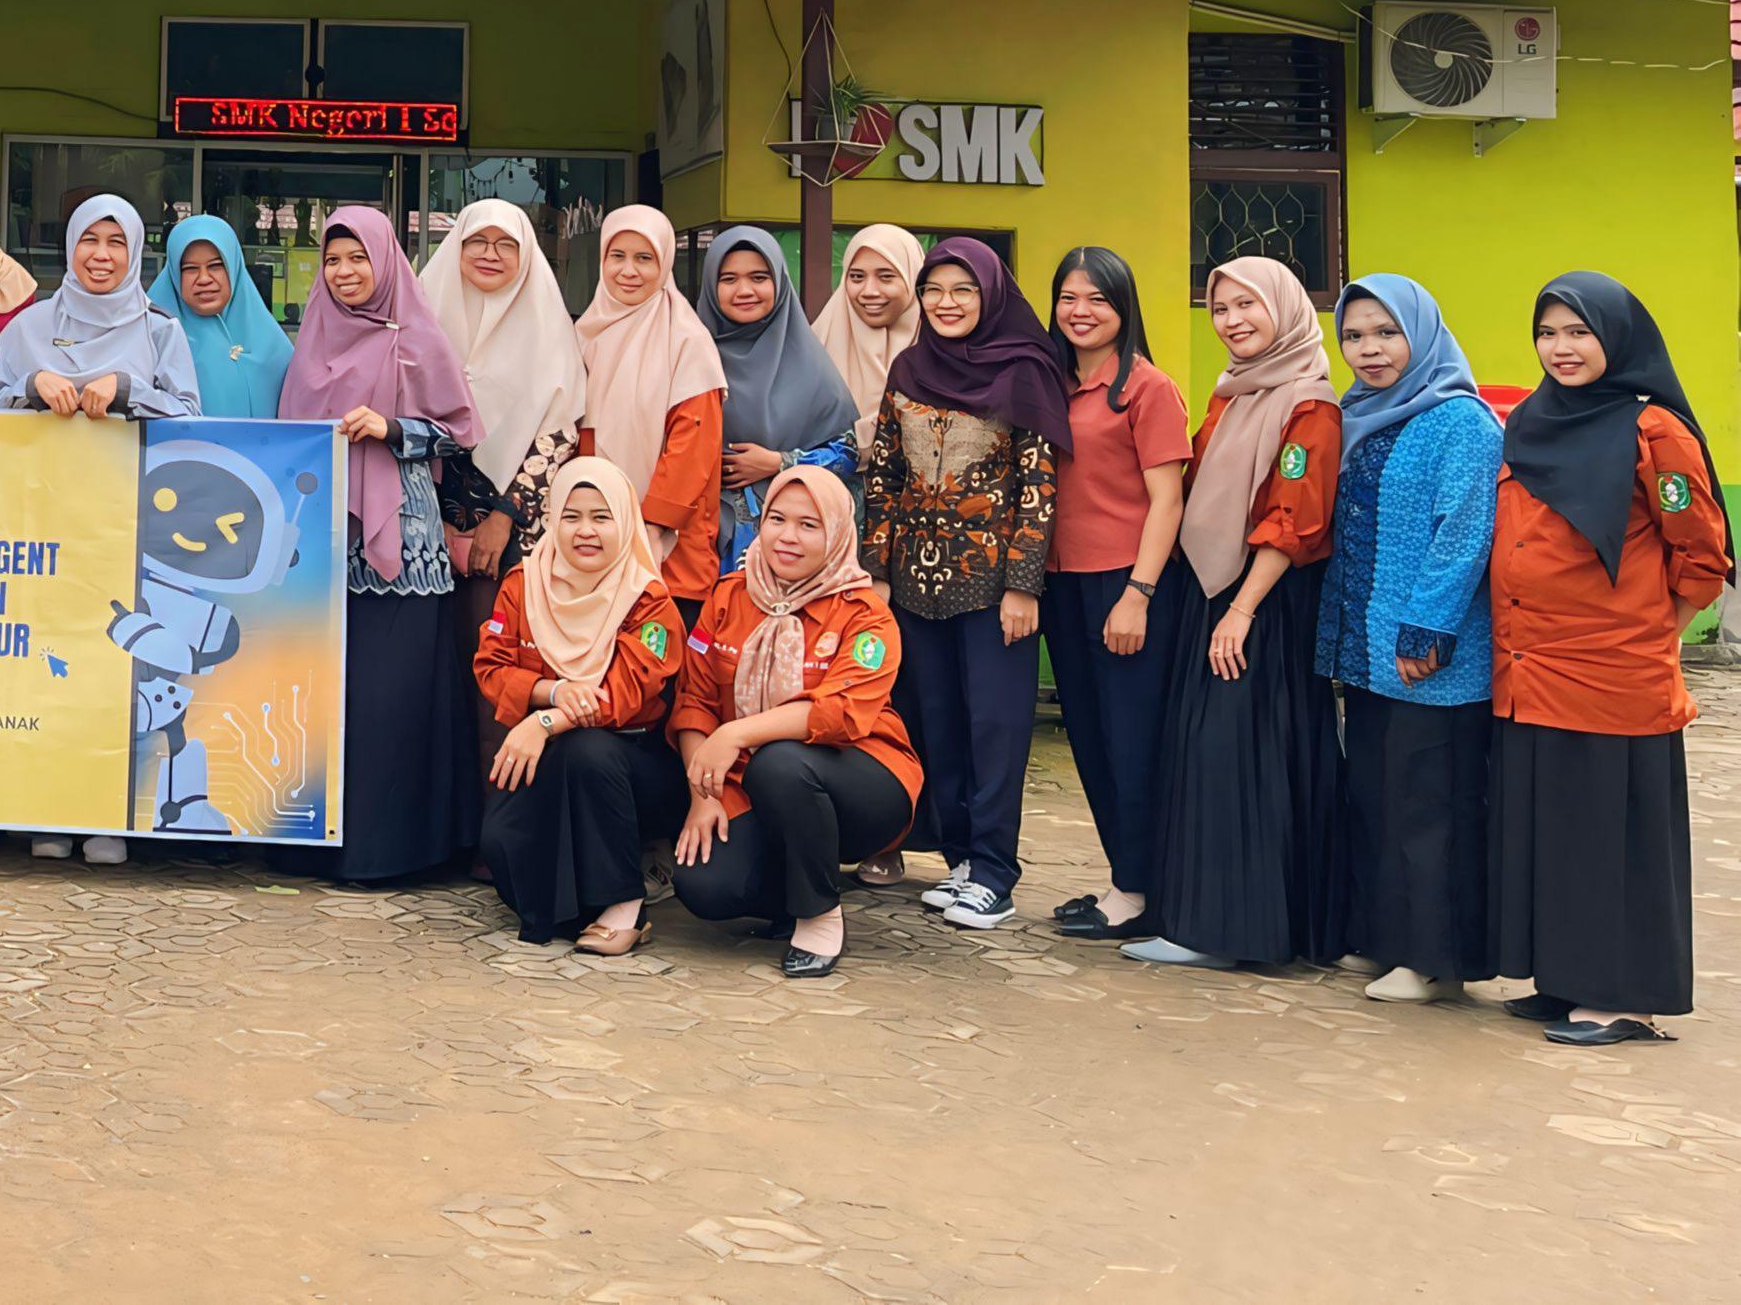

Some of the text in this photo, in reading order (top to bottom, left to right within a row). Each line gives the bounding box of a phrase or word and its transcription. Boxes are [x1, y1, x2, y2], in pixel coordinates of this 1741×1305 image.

[1518, 43, 1537, 55] LG
[211, 102, 278, 128] SMK
[898, 104, 1046, 186] SMK
